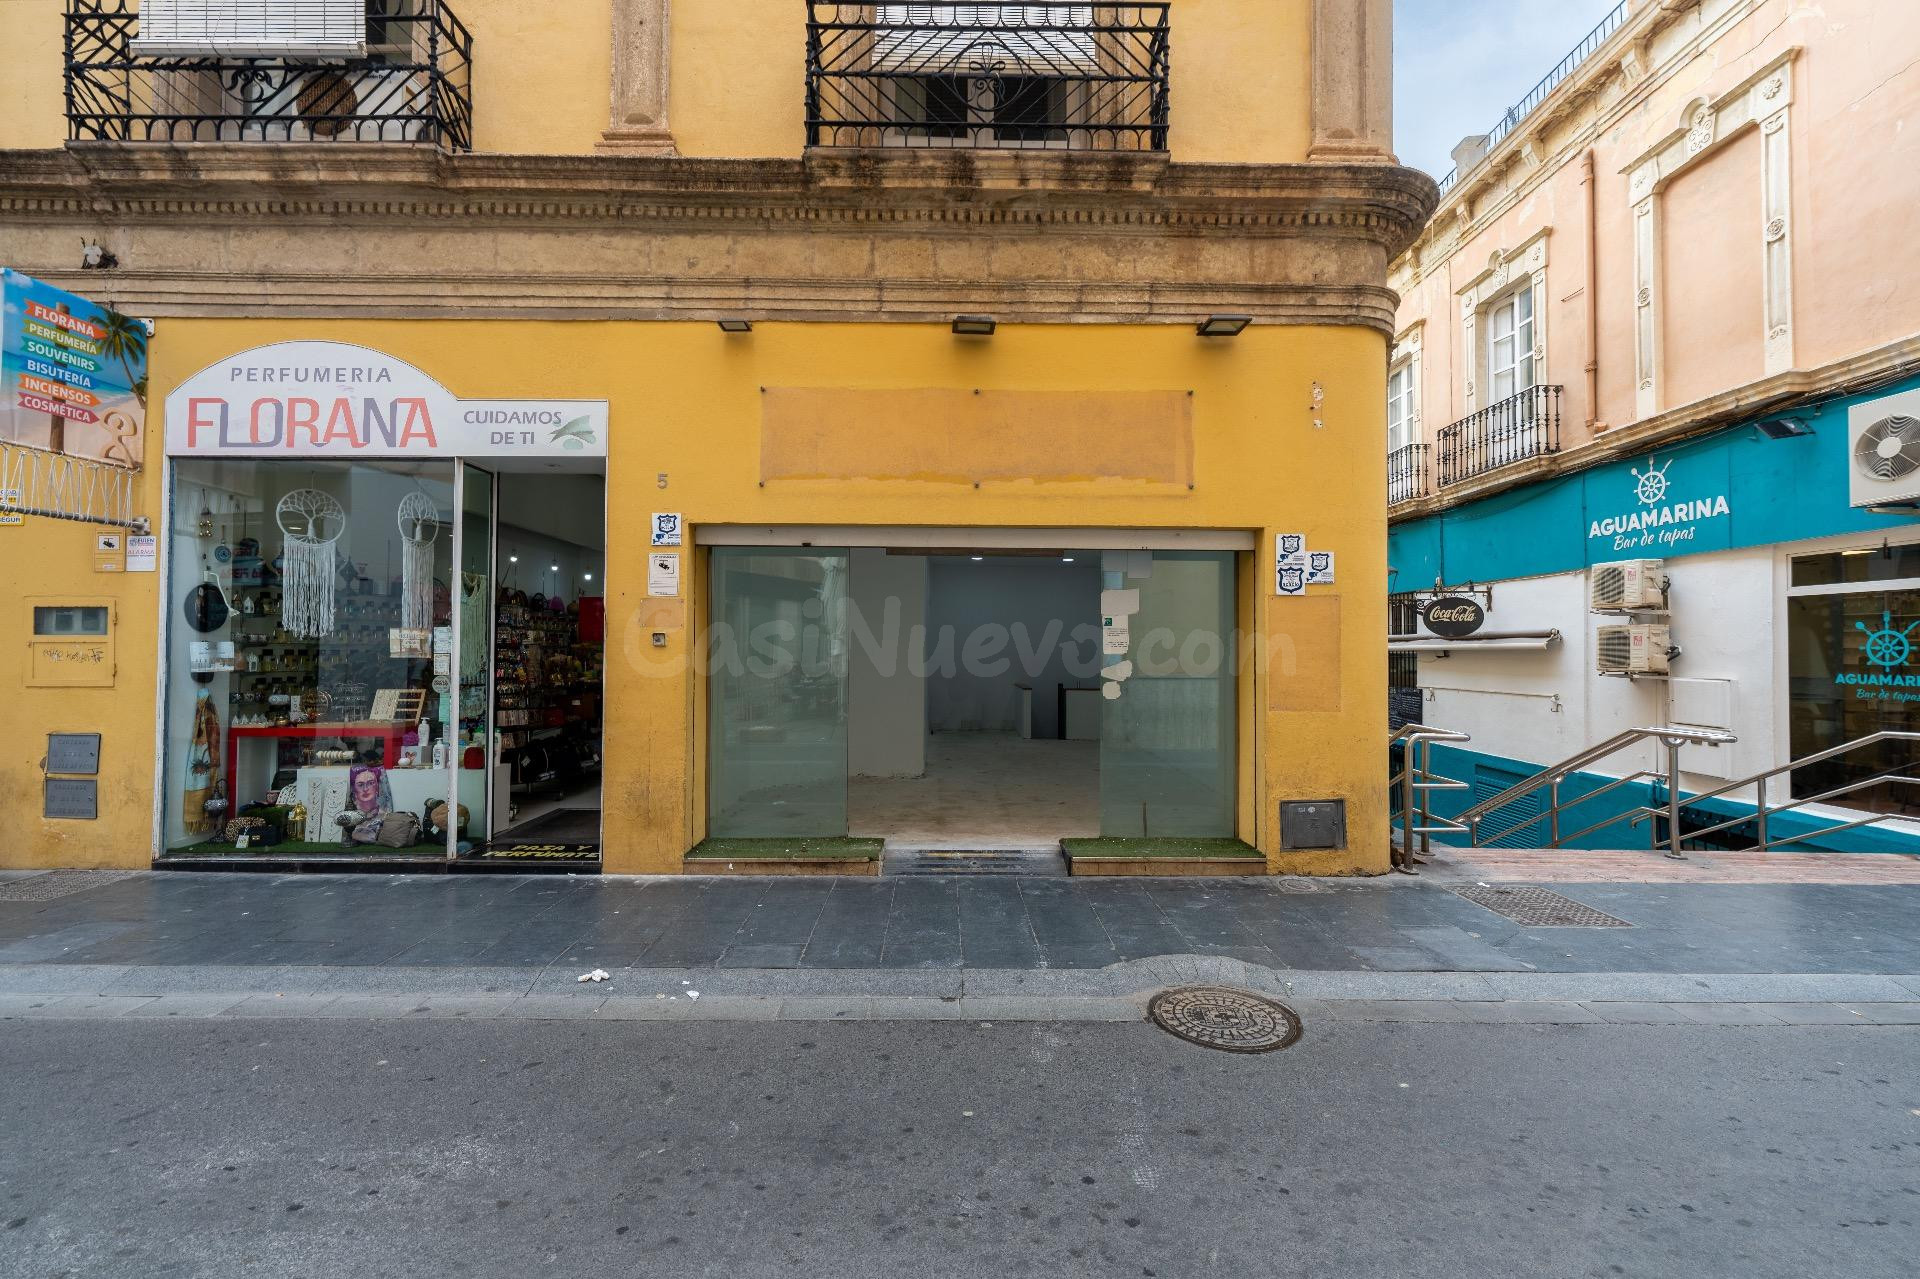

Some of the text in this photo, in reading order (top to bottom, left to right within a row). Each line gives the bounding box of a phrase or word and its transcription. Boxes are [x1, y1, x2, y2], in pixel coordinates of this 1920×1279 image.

[34, 305, 95, 337] FLORANA
[29, 323, 97, 354] PERFUMERÍA
[27, 341, 95, 371] SOUVENIRS
[27, 359, 91, 388] BISUTERÍA
[230, 367, 392, 383] PERFUMERIA
[25, 377, 91, 405] INCIENSOS
[24, 396, 91, 422] COSMÉTICA
[463, 410, 563, 425] CUIDAMOS
[187, 397, 438, 449] FLORANA
[490, 431, 535, 445] DE TI
[657, 473, 668, 489] 5
[1588, 495, 1730, 539] AGUAMARINA
[1613, 526, 1696, 551] Bar de tapas
[1429, 605, 1476, 622] Coca-Cola
[1856, 688, 1876, 699] Bar
[1878, 688, 1890, 699] de
